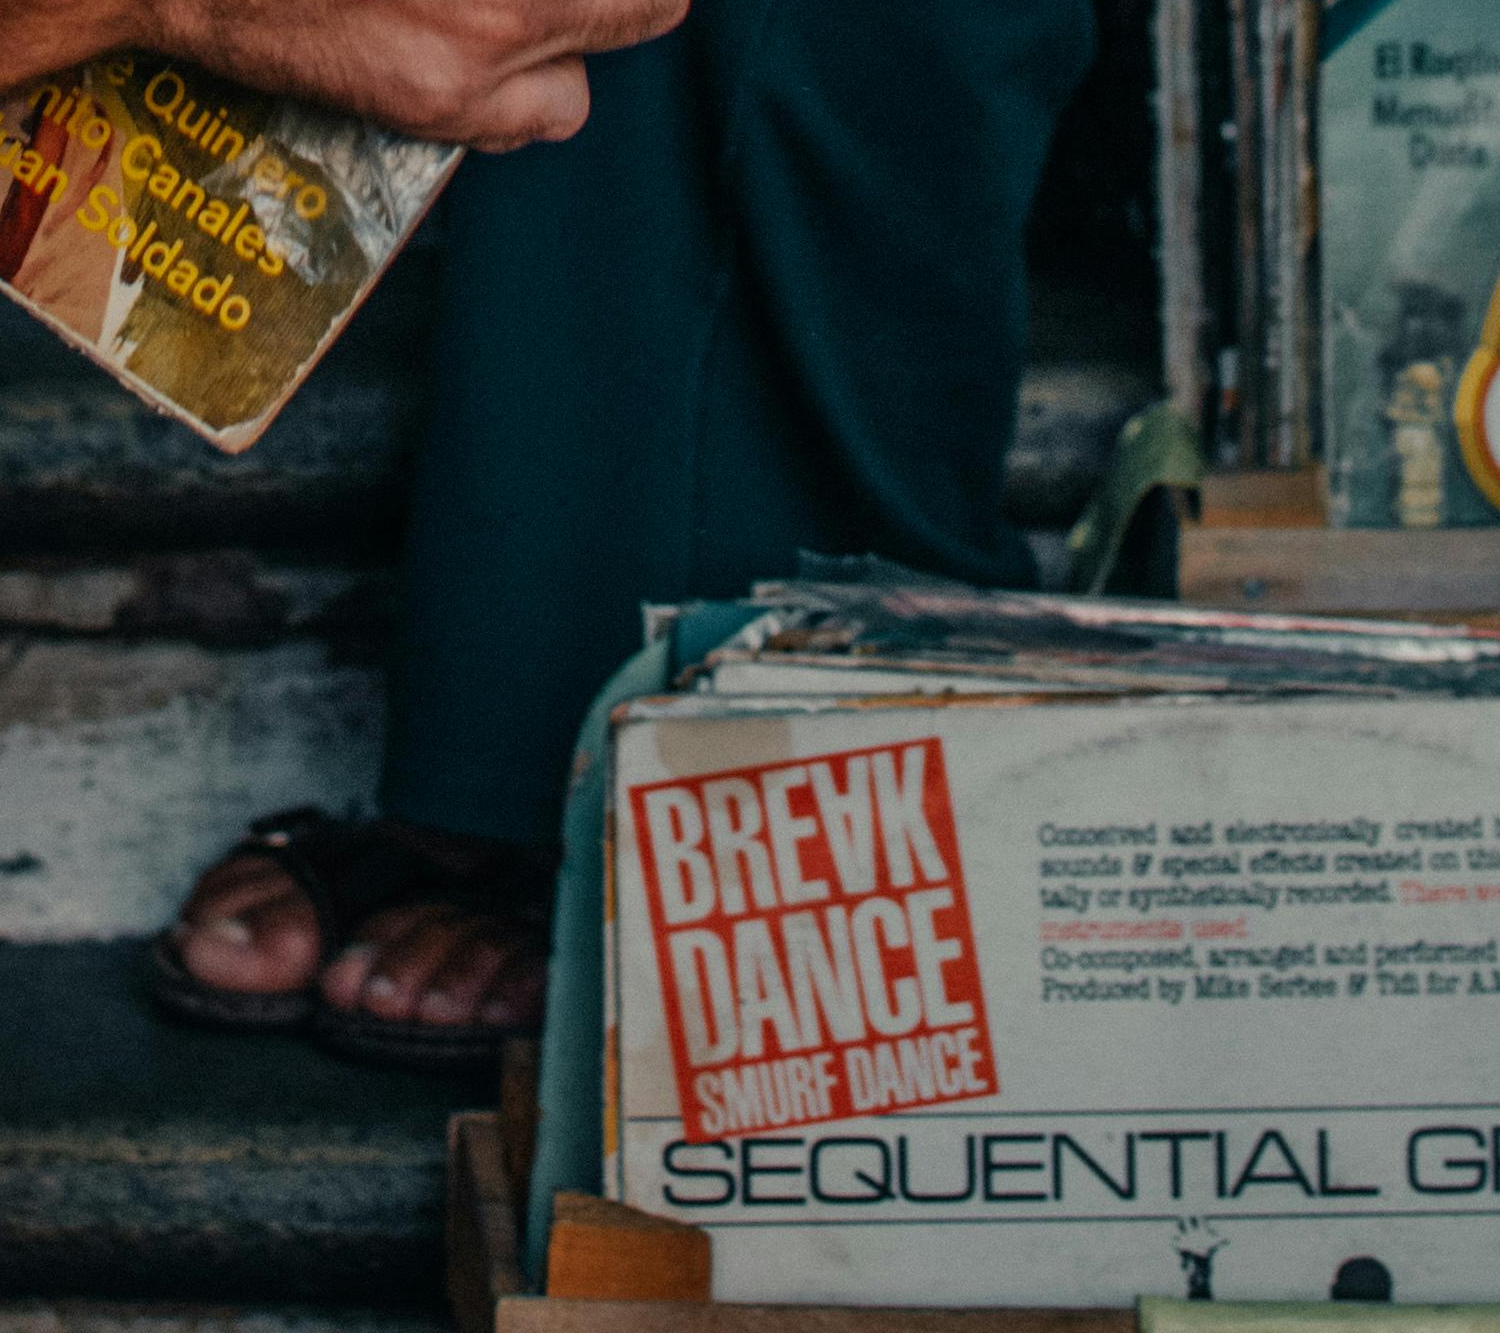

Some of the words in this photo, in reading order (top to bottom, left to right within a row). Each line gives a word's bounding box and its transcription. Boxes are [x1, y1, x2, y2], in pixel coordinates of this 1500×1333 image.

[120, 135, 286, 278] Canales
[77, 186, 252, 331] Soldado
[1170, 822, 1213, 845] and
[1225, 817, 1381, 847] electronically
[1394, 816, 1484, 842] created
[1039, 855, 1123, 878] sounds
[1160, 852, 1240, 879] special
[1249, 850, 1325, 876] effects
[1333, 849, 1422, 874] created
[1039, 884, 1091, 913] tally
[1099, 889, 1124, 910] or
[1129, 882, 1280, 912] synthetically
[668, 888, 974, 1068] DANCE
[1207, 941, 1316, 973] arranged
[1323, 941, 1367, 966] and
[1374, 938, 1497, 968] performed
[1040, 976, 1149, 1003] Produced
[1157, 978, 1187, 1006] by
[1194, 975, 1250, 999] Mike
[693, 1052, 838, 1134] SMURF
[846, 1028, 988, 1111] DANCE
[661, 1129, 1380, 1206] SEQUENTIAL
